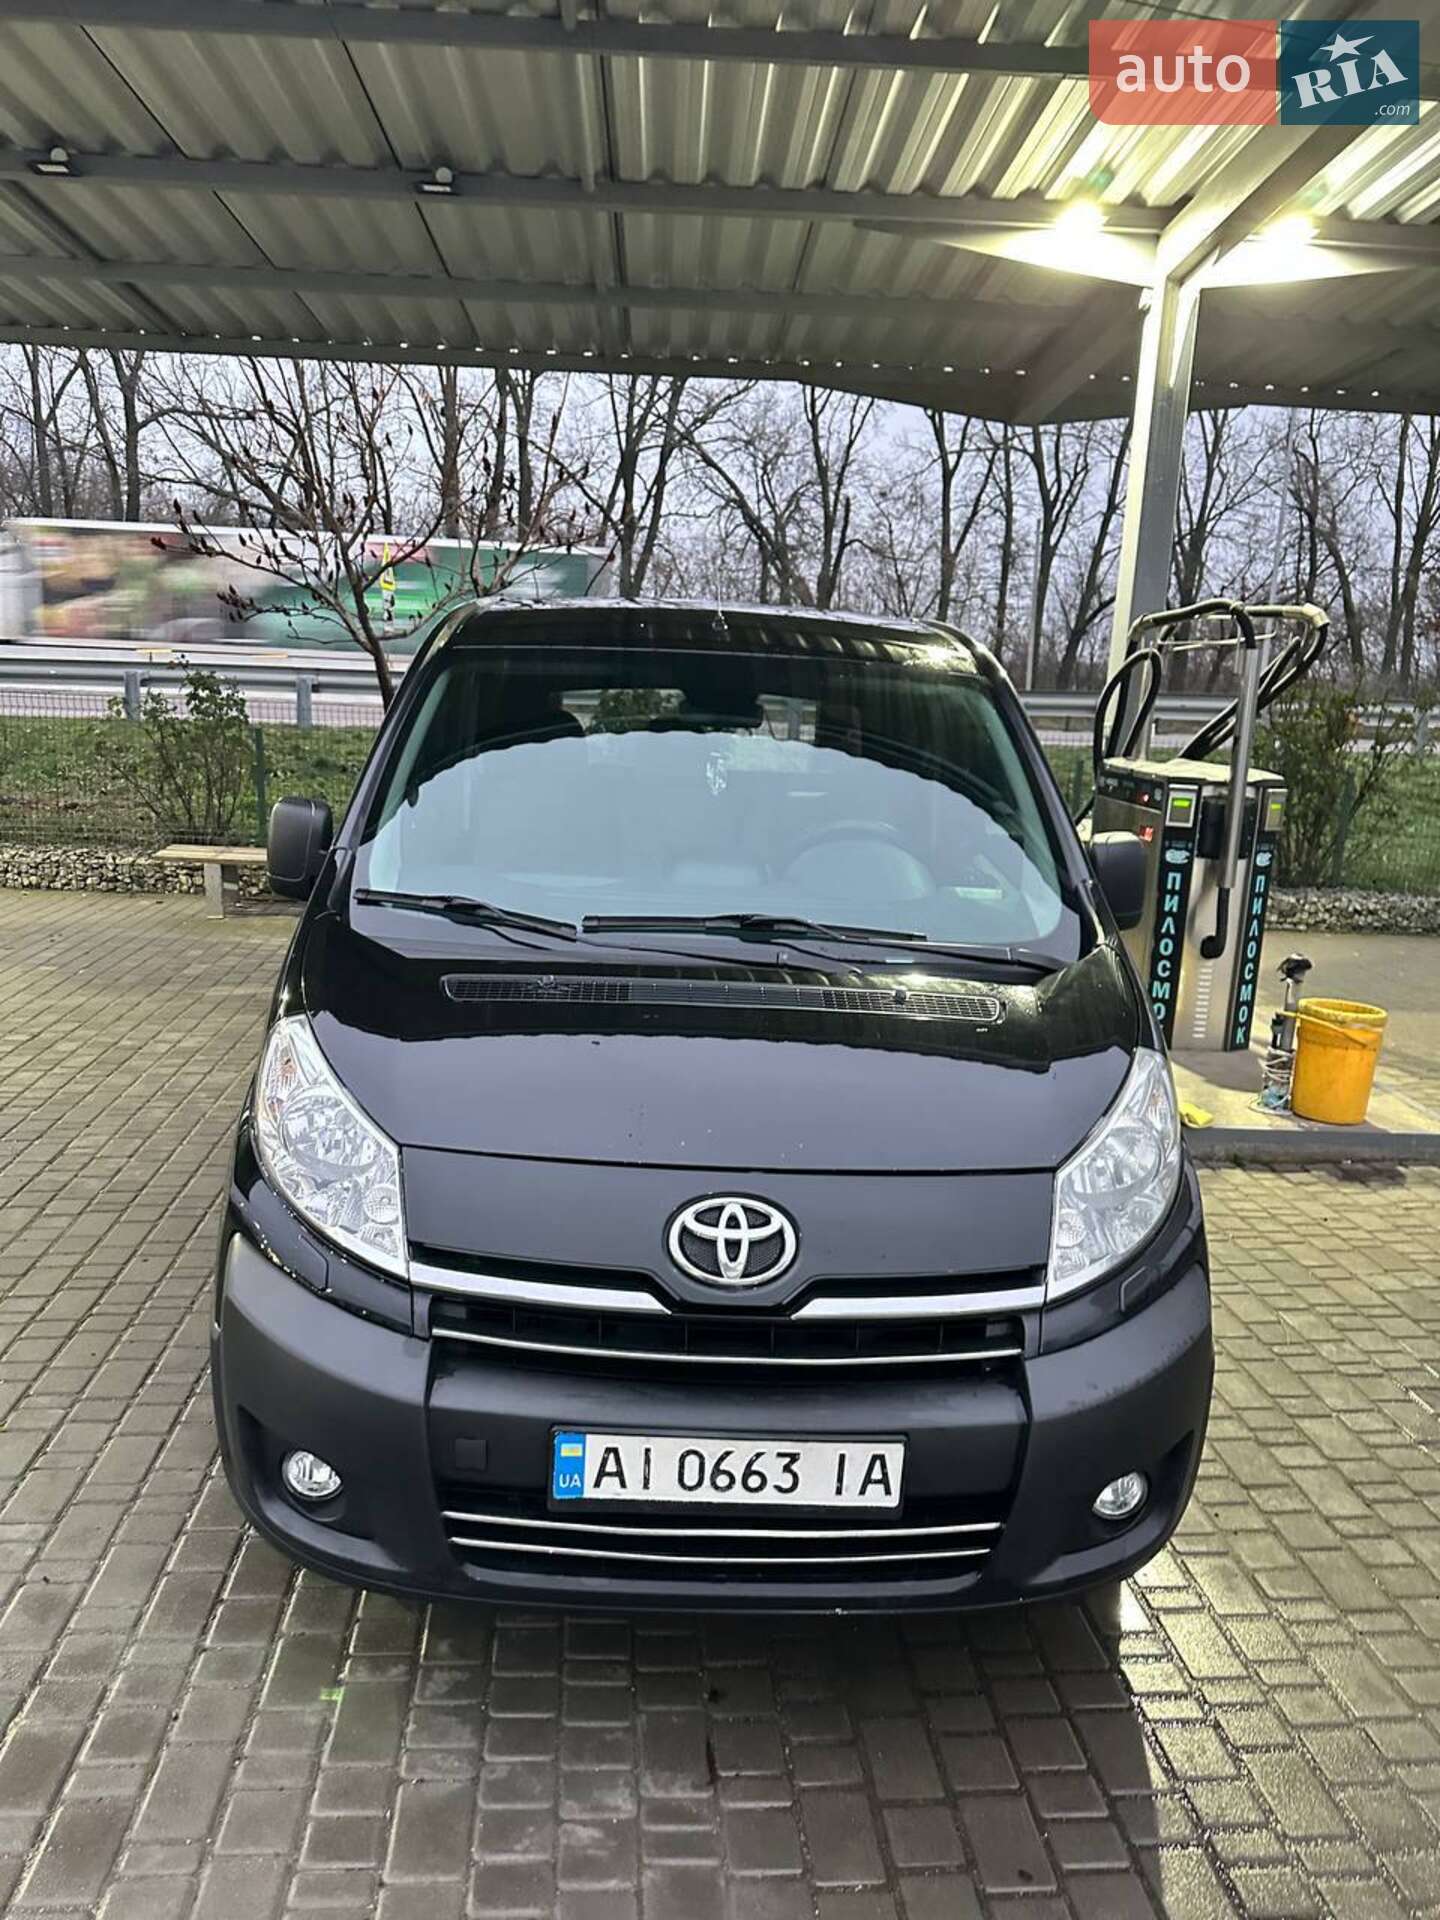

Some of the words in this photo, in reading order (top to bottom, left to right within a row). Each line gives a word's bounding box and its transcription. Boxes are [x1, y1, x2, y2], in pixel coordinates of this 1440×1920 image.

[1152, 871, 1182, 1029] ПИЛОСМО
[1235, 874, 1266, 1044] ПИЛОСМОК
[558, 1474, 582, 1489] UA
[593, 1446, 652, 1490] AI
[677, 1449, 802, 1494] 0663
[834, 1453, 893, 1497] IA
